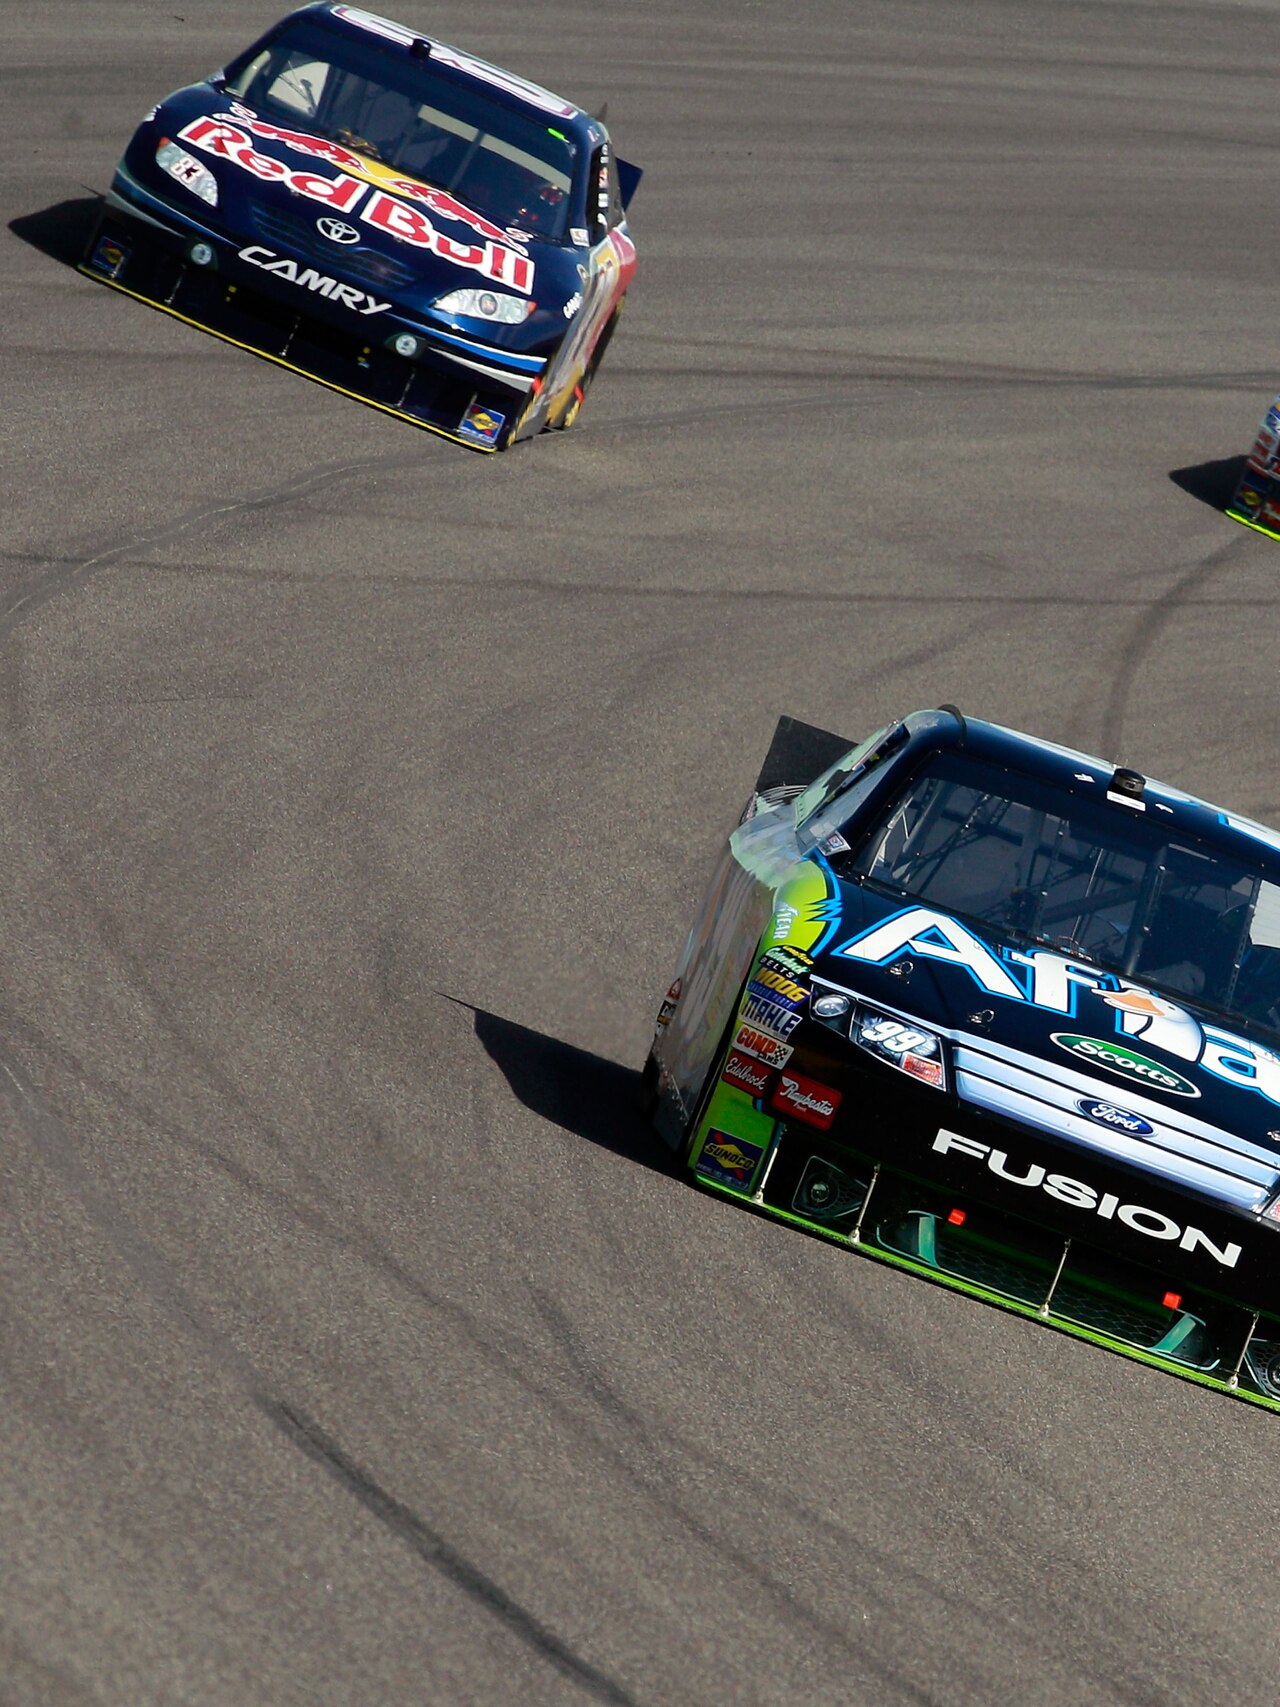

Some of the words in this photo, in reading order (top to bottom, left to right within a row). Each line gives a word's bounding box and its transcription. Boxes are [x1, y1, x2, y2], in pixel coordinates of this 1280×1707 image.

[176, 116, 368, 214] Red
[360, 190, 535, 295] Bull
[238, 245, 392, 315] CAMRY
[754, 966, 812, 1003] MOOG
[759, 956, 796, 979] BELTS
[742, 999, 802, 1037] MAHLE
[735, 1026, 778, 1055] COMP
[861, 1020, 927, 1053] 99
[725, 1057, 767, 1092] Edelbrock
[757, 1050, 781, 1067] CAMS
[1072, 1040, 1180, 1088] Scotts
[781, 1076, 835, 1118] Raybestos
[1091, 1103, 1144, 1132] Ford
[704, 1142, 756, 1172] SUNOCO
[931, 1128, 1243, 1269] FUSION
